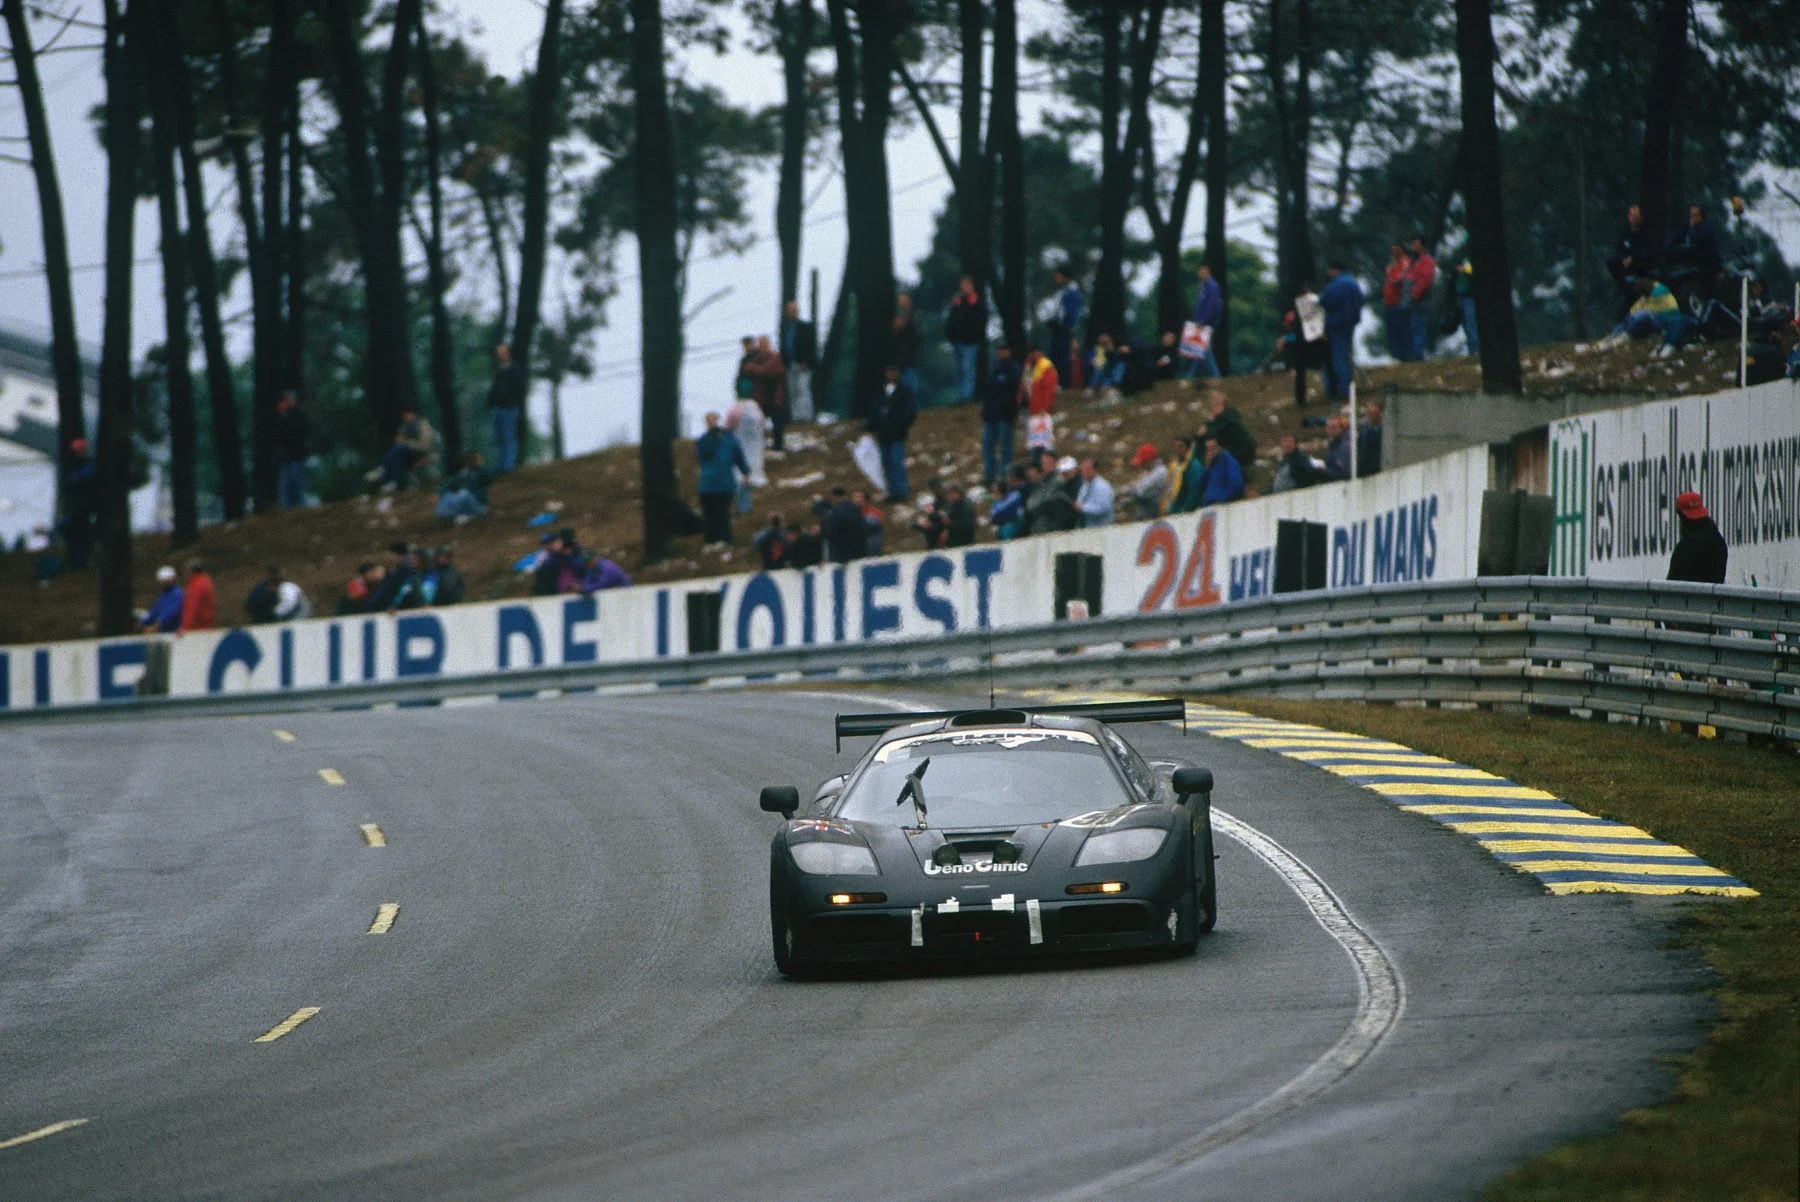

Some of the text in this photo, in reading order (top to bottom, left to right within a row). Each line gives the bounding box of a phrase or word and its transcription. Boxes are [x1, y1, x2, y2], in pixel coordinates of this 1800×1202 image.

[1590, 420, 1614, 561] les
[1722, 443, 1760, 548] mans
[1761, 433, 1800, 545] assur
[1136, 510, 1222, 613] 24
[1332, 517, 1367, 588] DU
[1372, 492, 1438, 583] MANS
[208, 613, 447, 694] CLUB
[497, 598, 599, 669] DE
[974, 858, 1029, 873] Clinic
